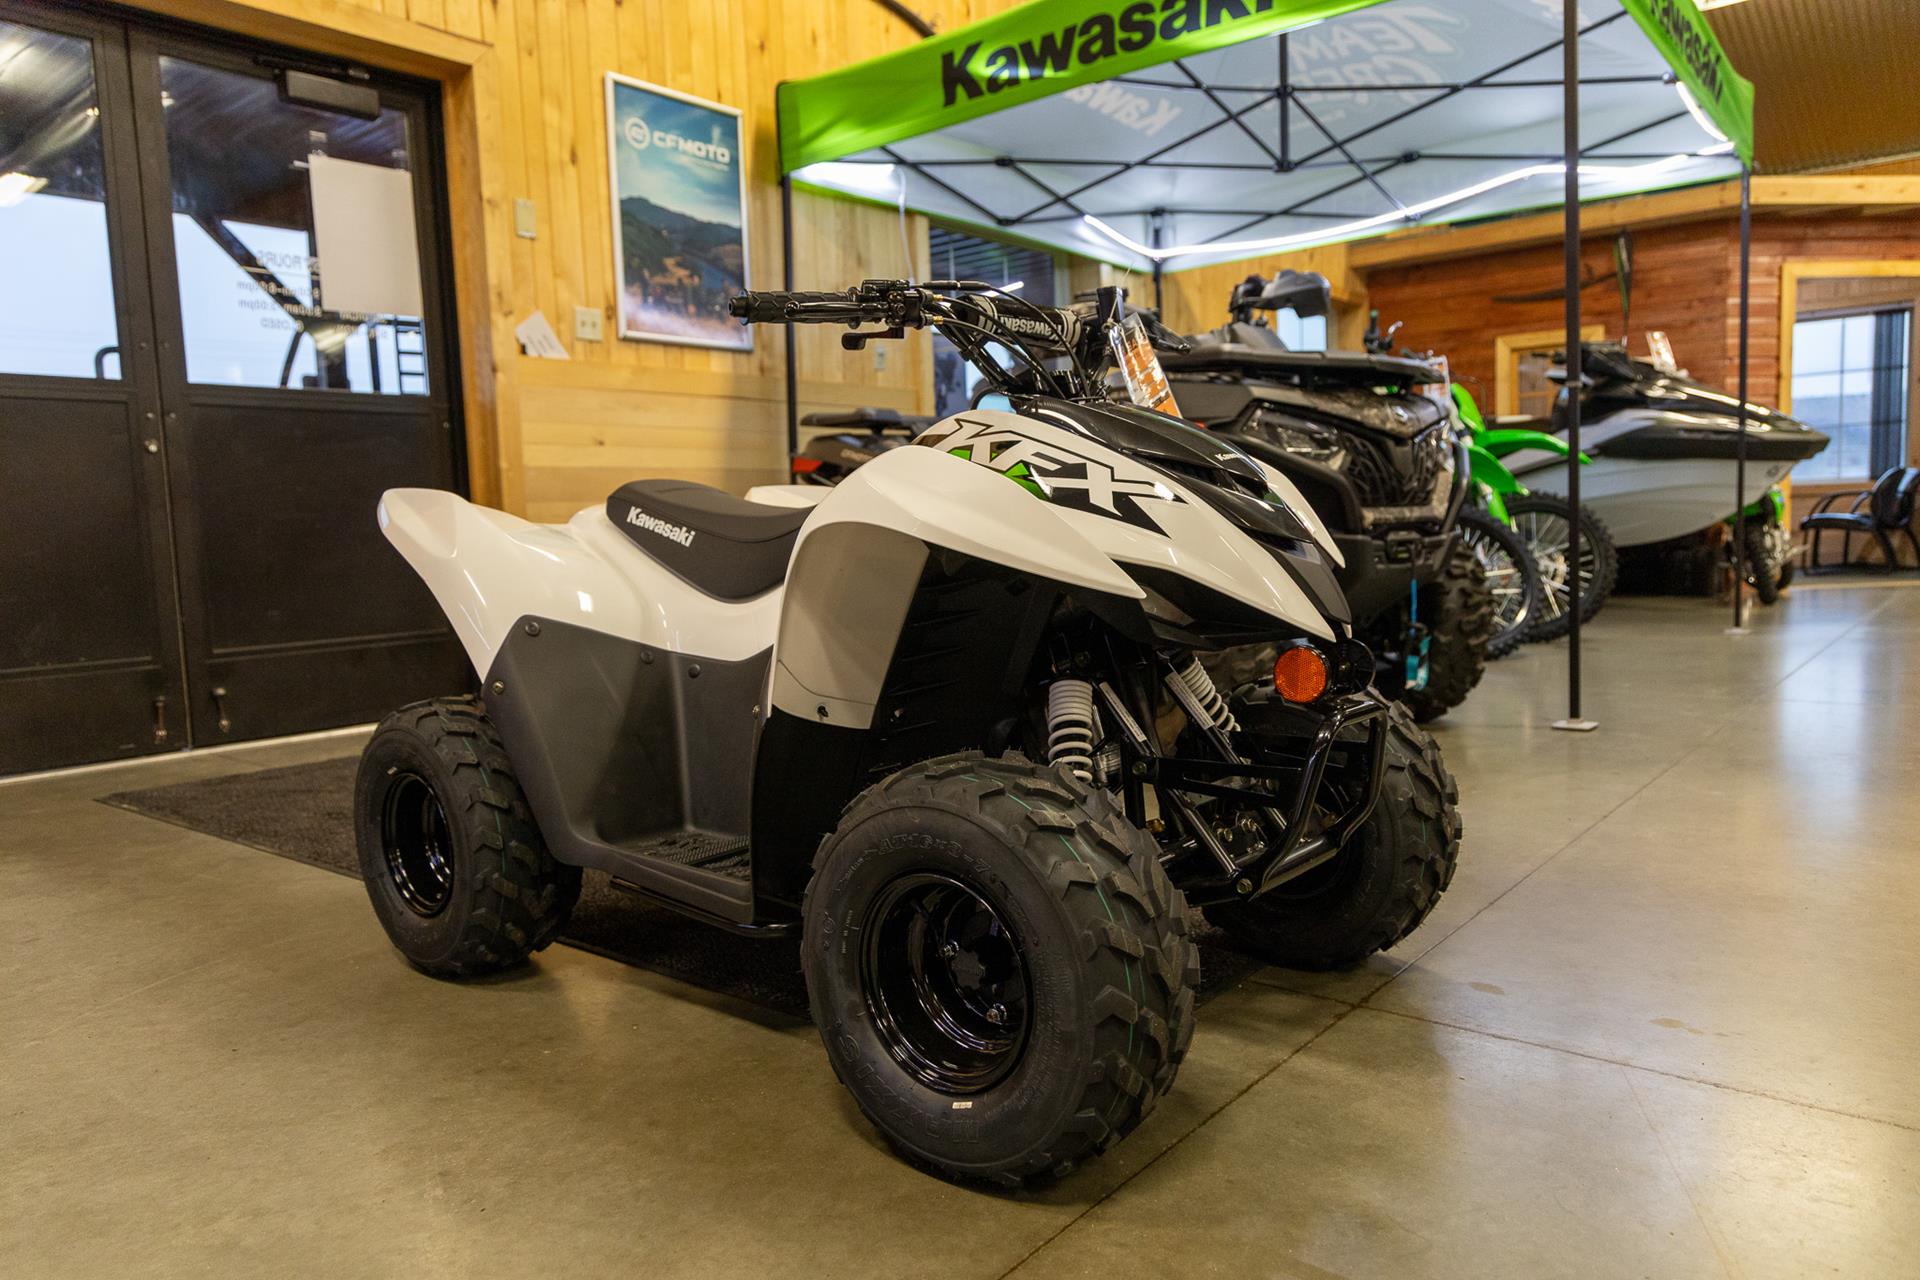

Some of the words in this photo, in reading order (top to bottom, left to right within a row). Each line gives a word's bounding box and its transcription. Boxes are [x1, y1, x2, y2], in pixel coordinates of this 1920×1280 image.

[941, 0, 1274, 108] Kawasa
[652, 130, 731, 164] CFMOTO
[930, 418, 1188, 518] KFX
[626, 506, 696, 547] Kawasaki
